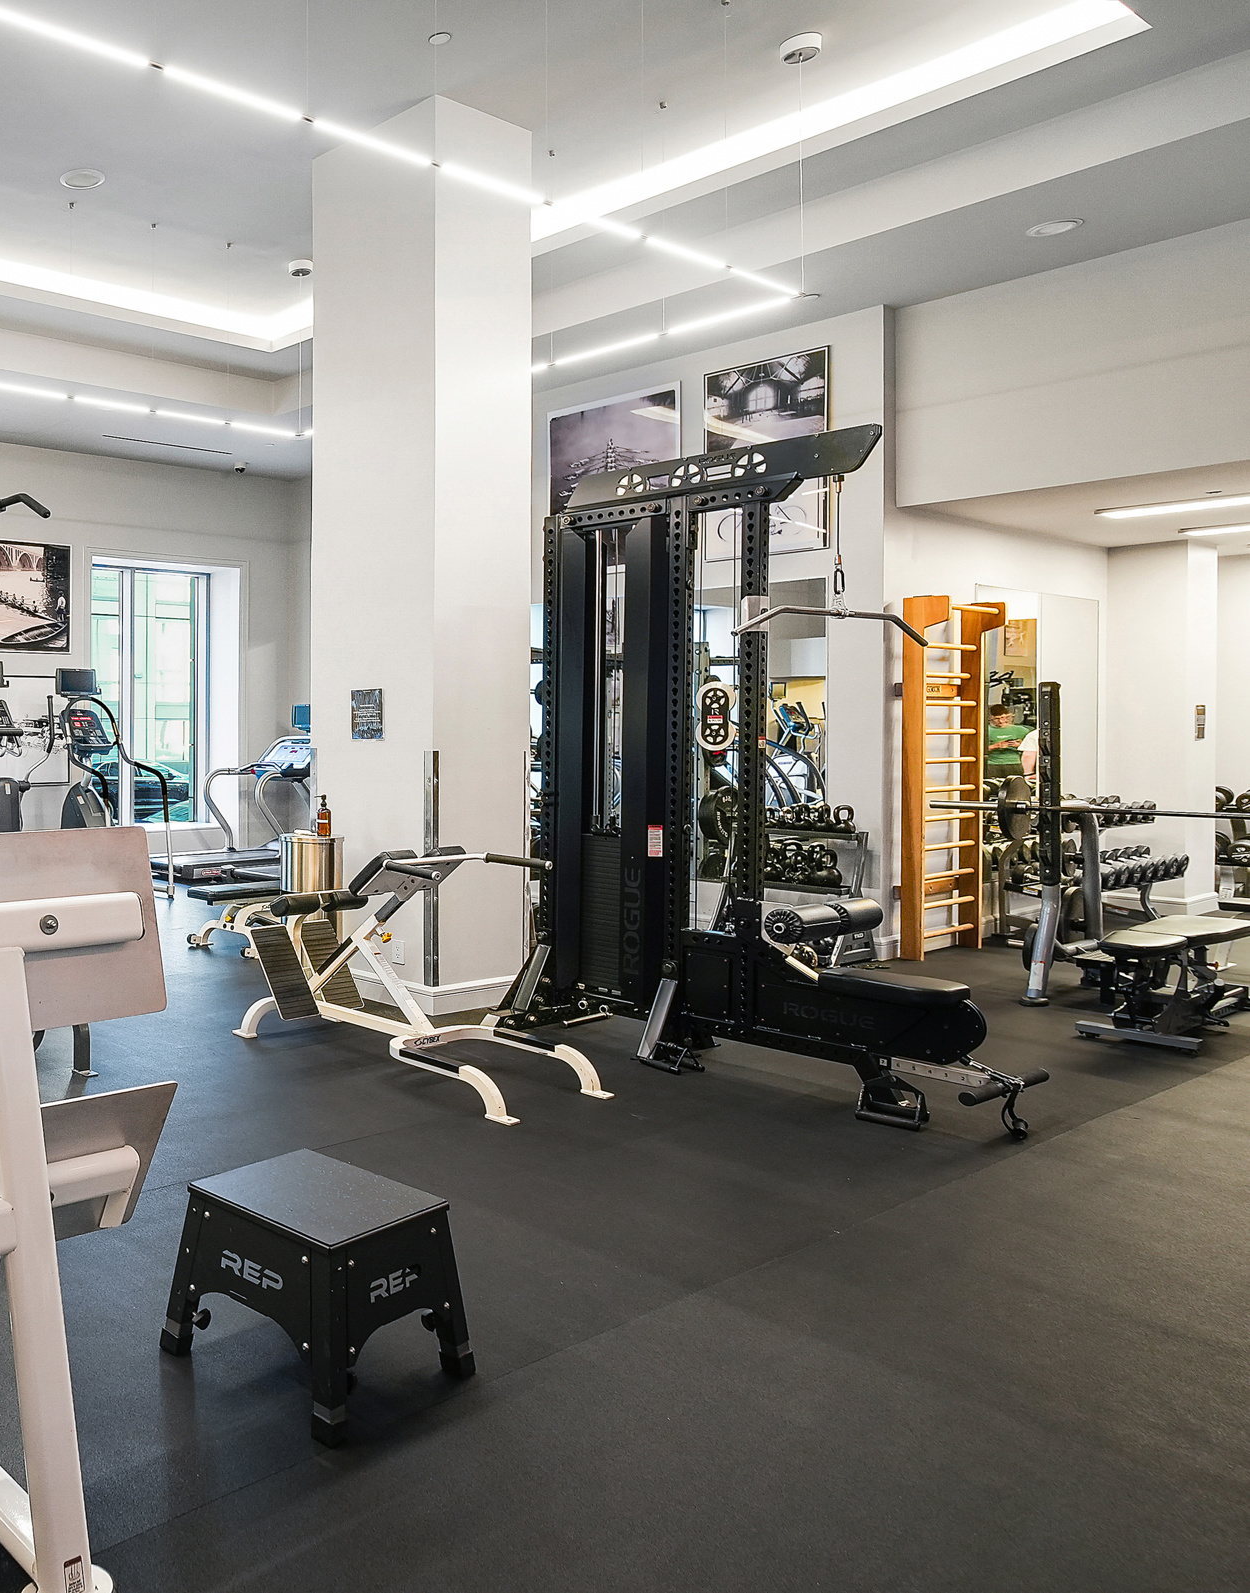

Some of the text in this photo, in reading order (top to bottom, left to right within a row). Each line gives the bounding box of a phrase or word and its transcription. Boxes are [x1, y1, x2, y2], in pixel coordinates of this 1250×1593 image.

[623, 867, 641, 975] ROGUE
[783, 1002, 874, 1030] ROGUE
[220, 1249, 284, 1291] REP
[370, 1263, 422, 1303] REP
